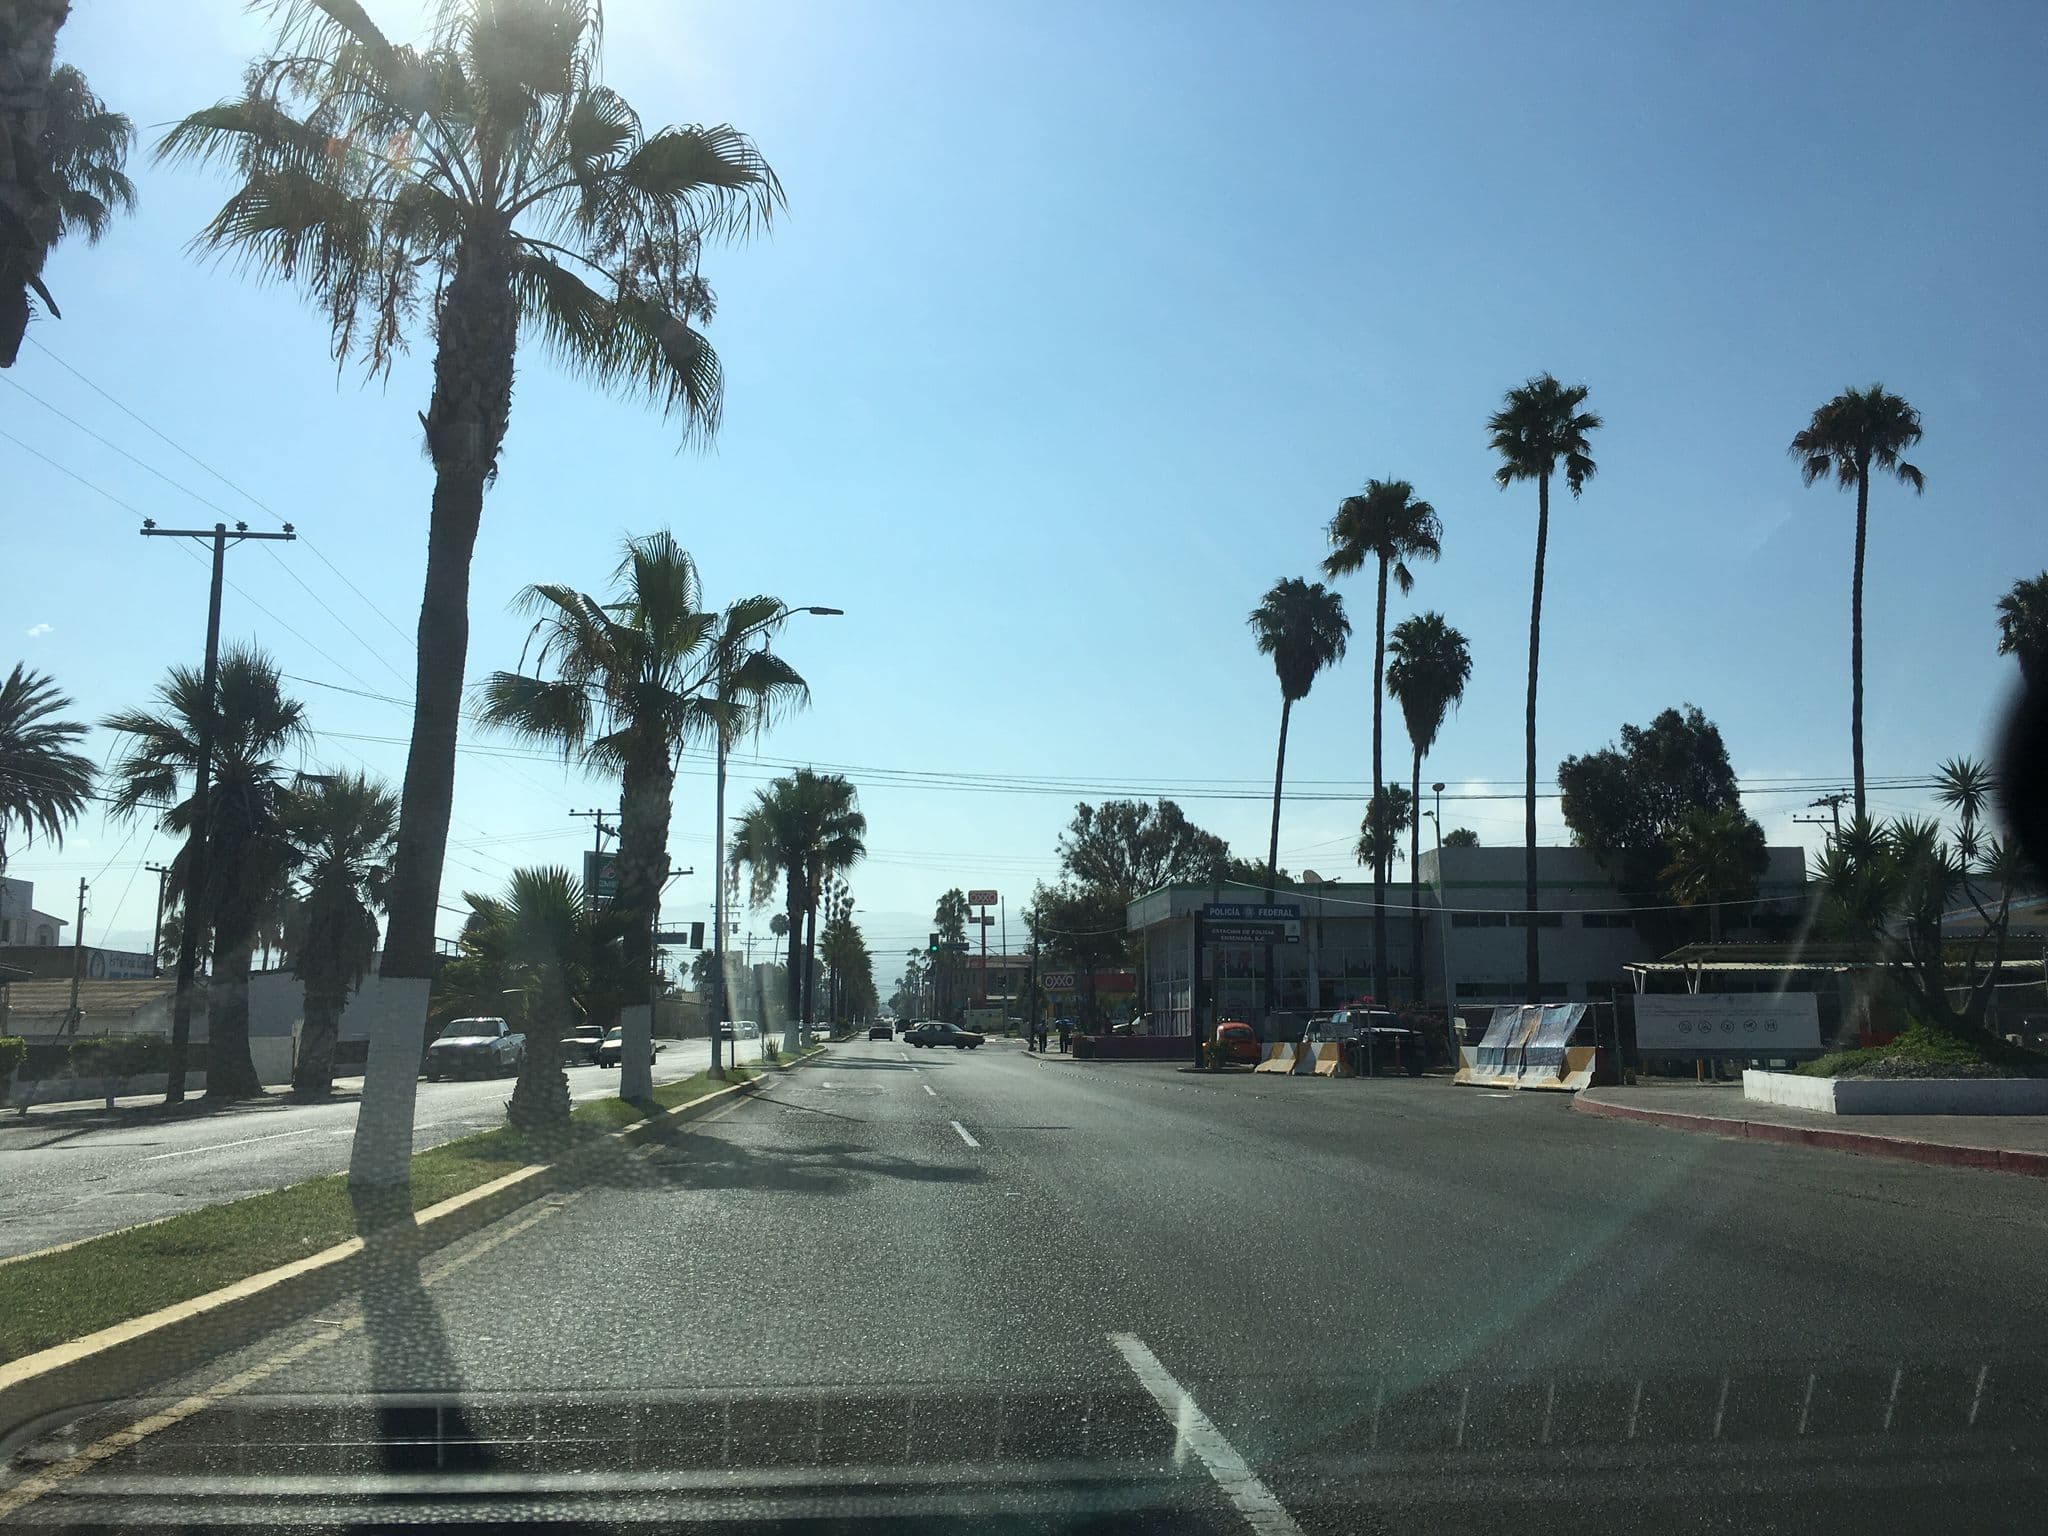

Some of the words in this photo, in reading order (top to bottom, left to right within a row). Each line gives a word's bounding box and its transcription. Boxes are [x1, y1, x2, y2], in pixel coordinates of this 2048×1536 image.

[970, 893, 995, 903] OXXO
[1209, 907, 1240, 916] POLICÍA
[1258, 908, 1294, 917] FEDERAL
[1045, 975, 1074, 989] OXXO
